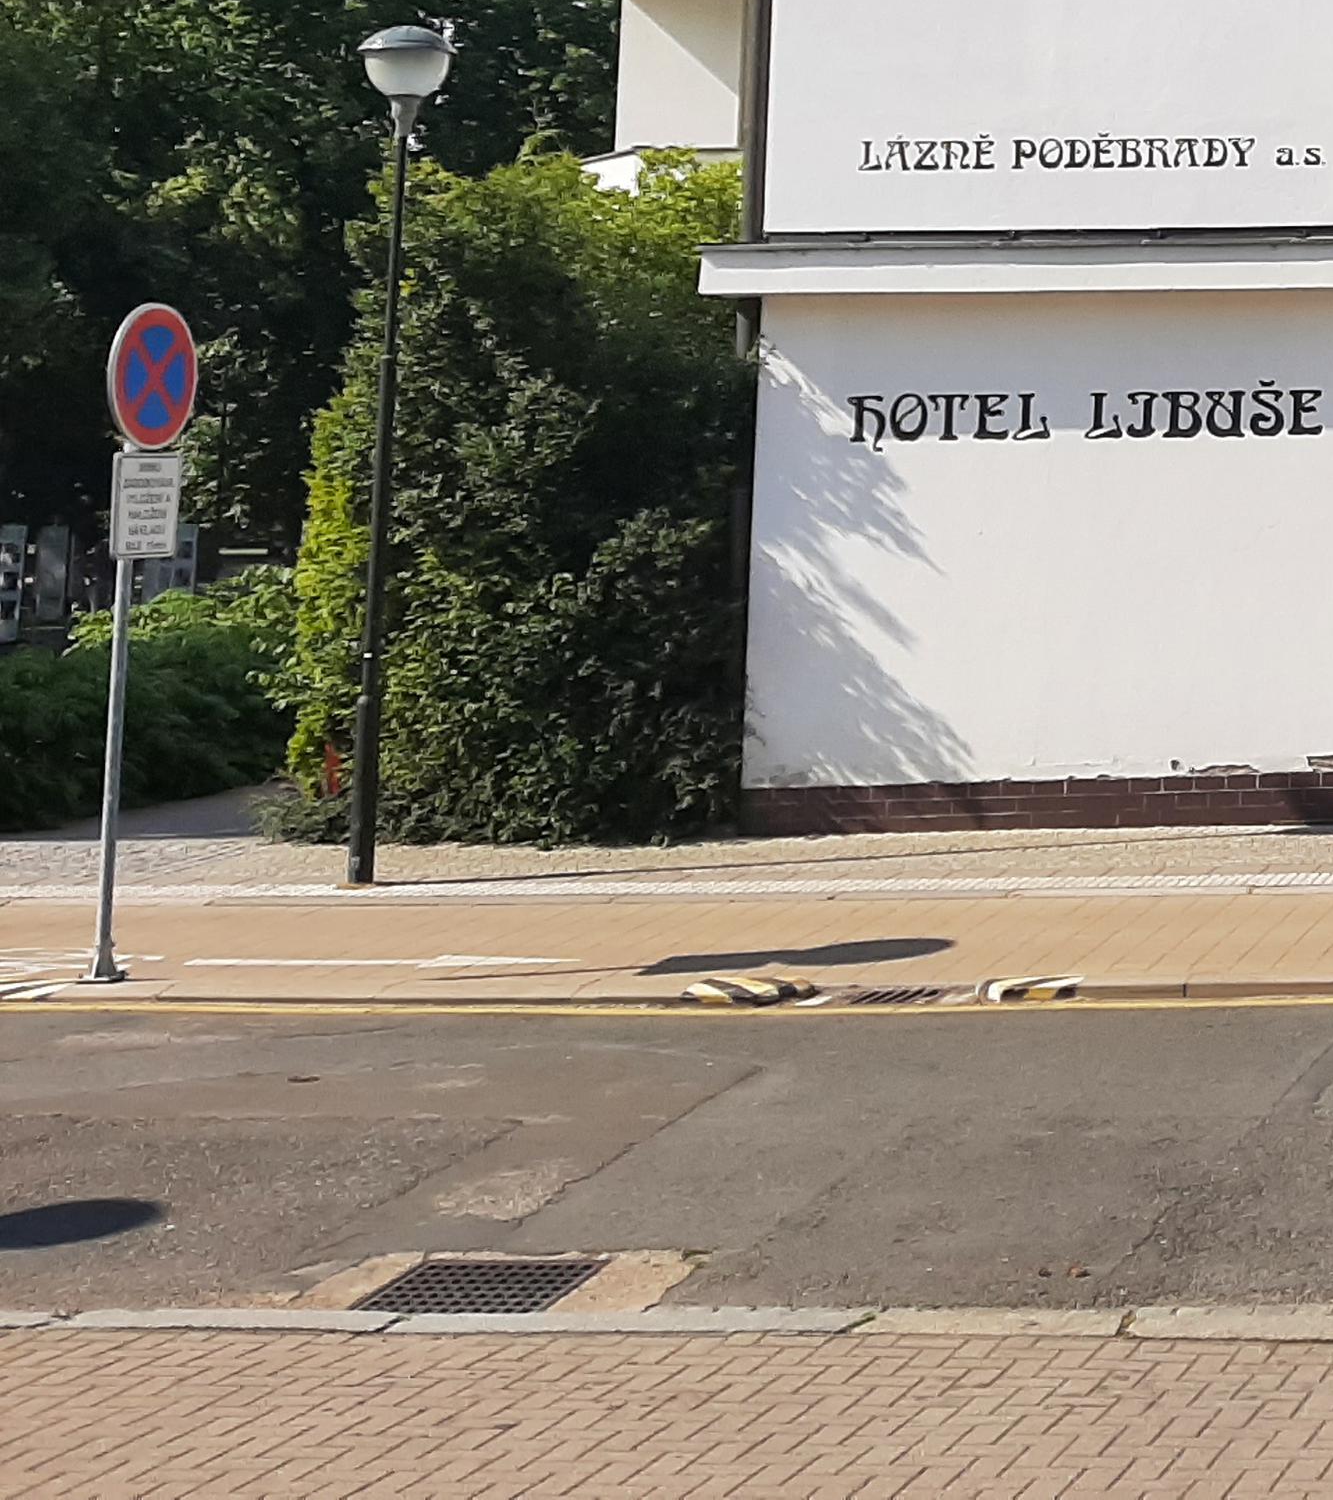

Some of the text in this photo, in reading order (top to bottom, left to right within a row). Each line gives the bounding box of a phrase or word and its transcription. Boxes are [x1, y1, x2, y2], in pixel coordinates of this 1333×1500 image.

[858, 134, 995, 172] LÁZNĚ
[1011, 133, 1256, 170] PODĚBRADY
[847, 392, 1051, 453] HOTEL
